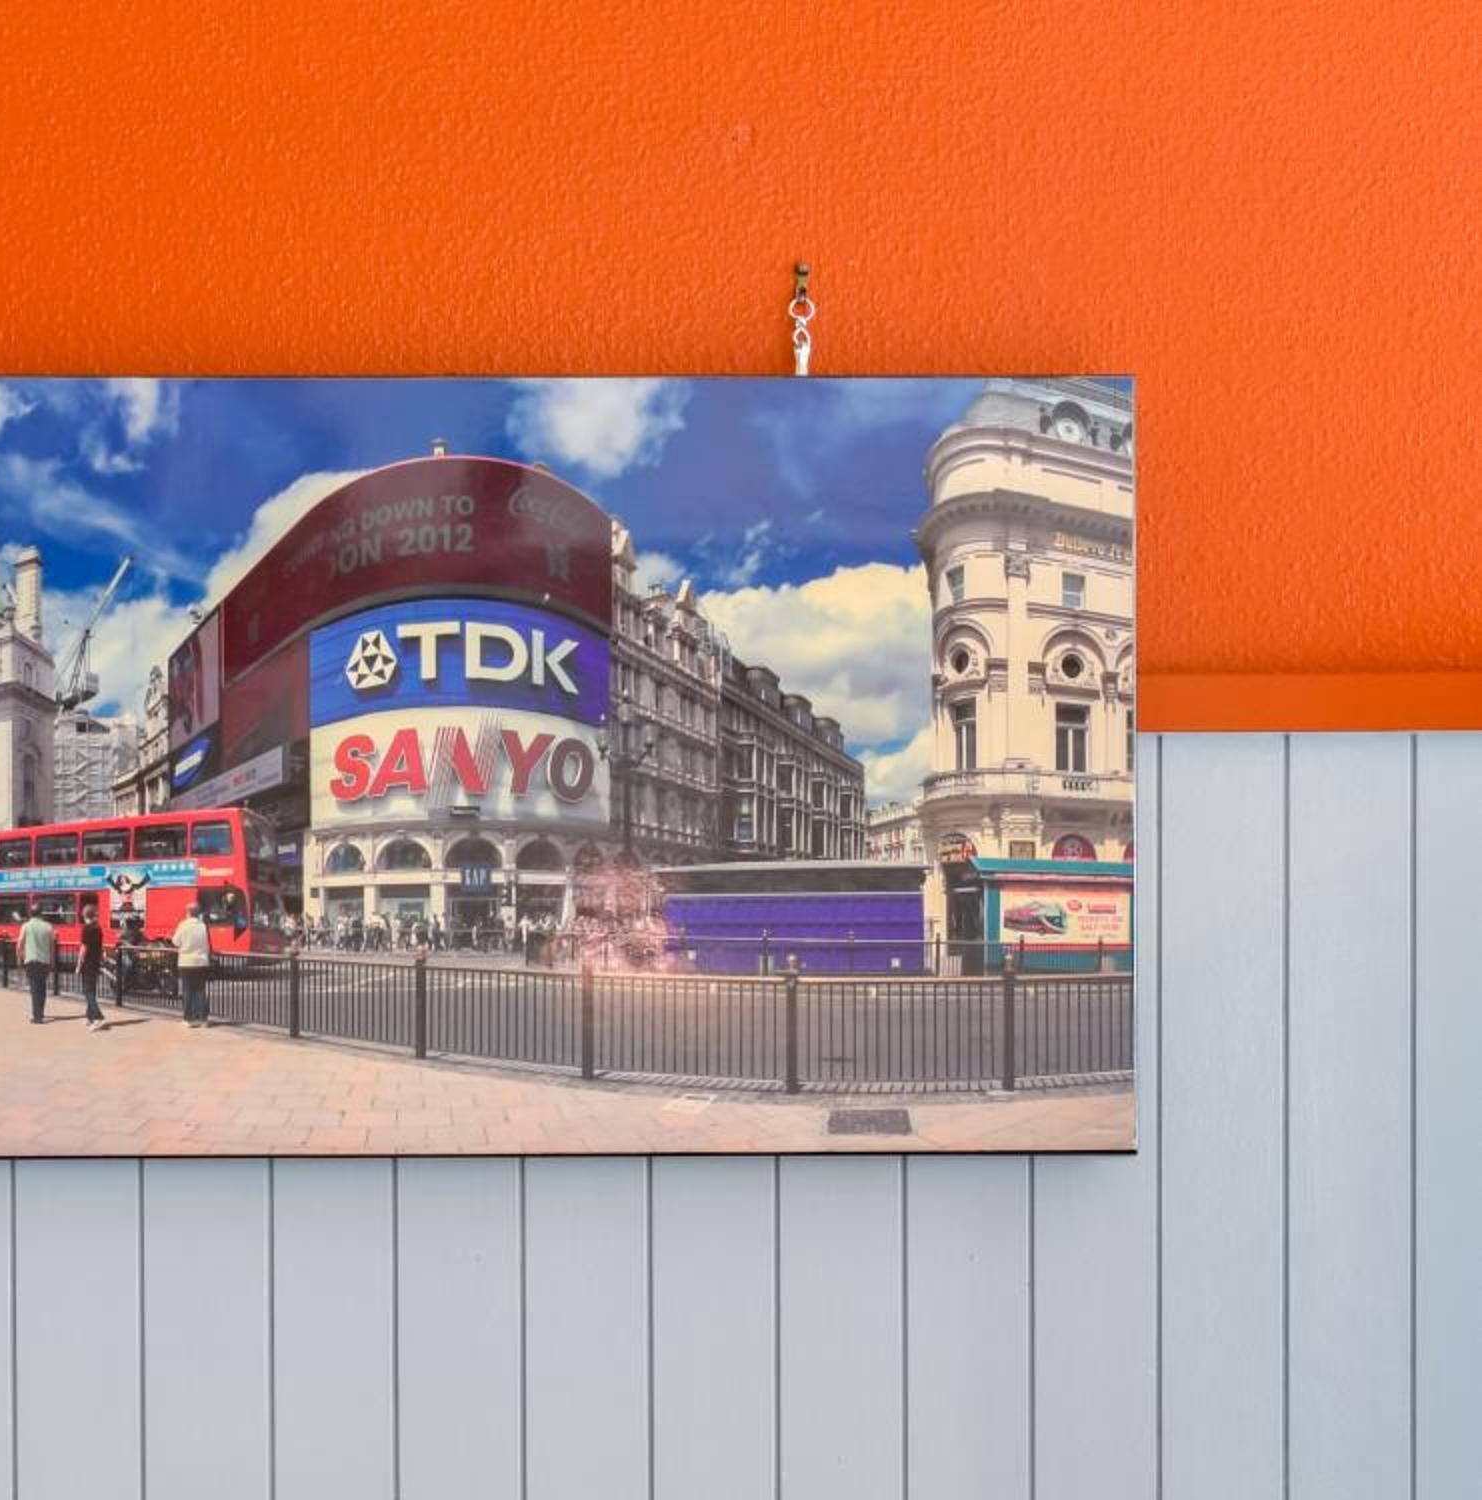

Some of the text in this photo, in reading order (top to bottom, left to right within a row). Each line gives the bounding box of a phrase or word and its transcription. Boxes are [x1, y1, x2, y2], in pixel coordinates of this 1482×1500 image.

[361, 496, 434, 532] DOWN
[440, 495, 474, 516] TO
[396, 522, 474, 557] 2012
[396, 621, 579, 695] TDK
[329, 716, 595, 804] SANYO
